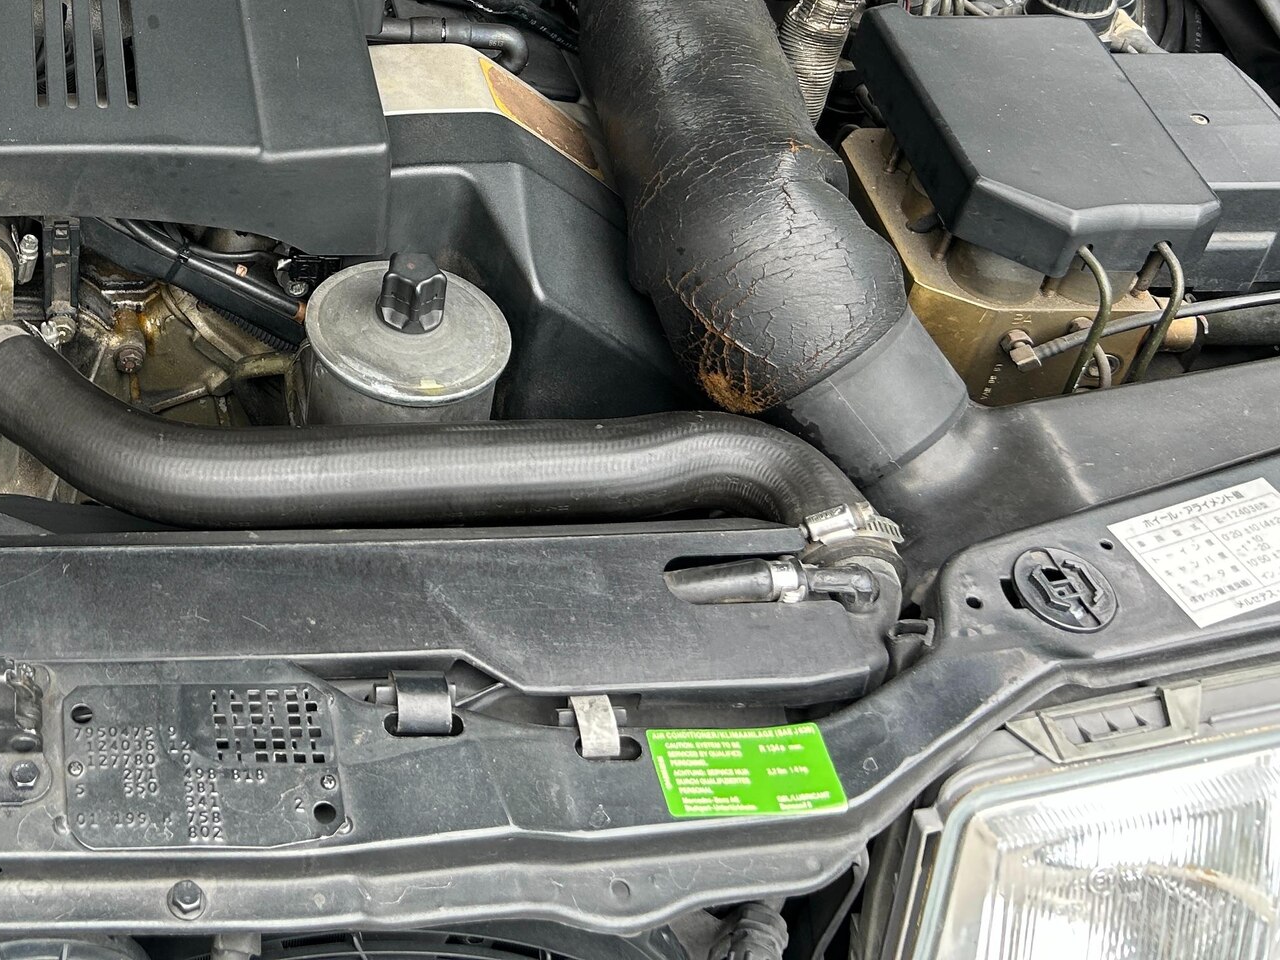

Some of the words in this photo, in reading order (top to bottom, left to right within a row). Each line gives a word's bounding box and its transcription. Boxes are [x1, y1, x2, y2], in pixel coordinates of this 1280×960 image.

[74, 727, 154, 740] 7950475
[168, 726, 177, 739] 9
[86, 740, 155, 754] 124036
[169, 740, 190, 753] 12
[87, 754, 156, 769] 127780
[124, 769, 157, 782] 271
[184, 769, 216, 782] 498
[232, 769, 265, 782] 818
[124, 782, 158, 797] 550
[184, 782, 218, 796] 581
[186, 796, 220, 811] 341
[295, 798, 305, 813] 2
[187, 811, 222, 826] 758
[188, 826, 224, 841] 802
